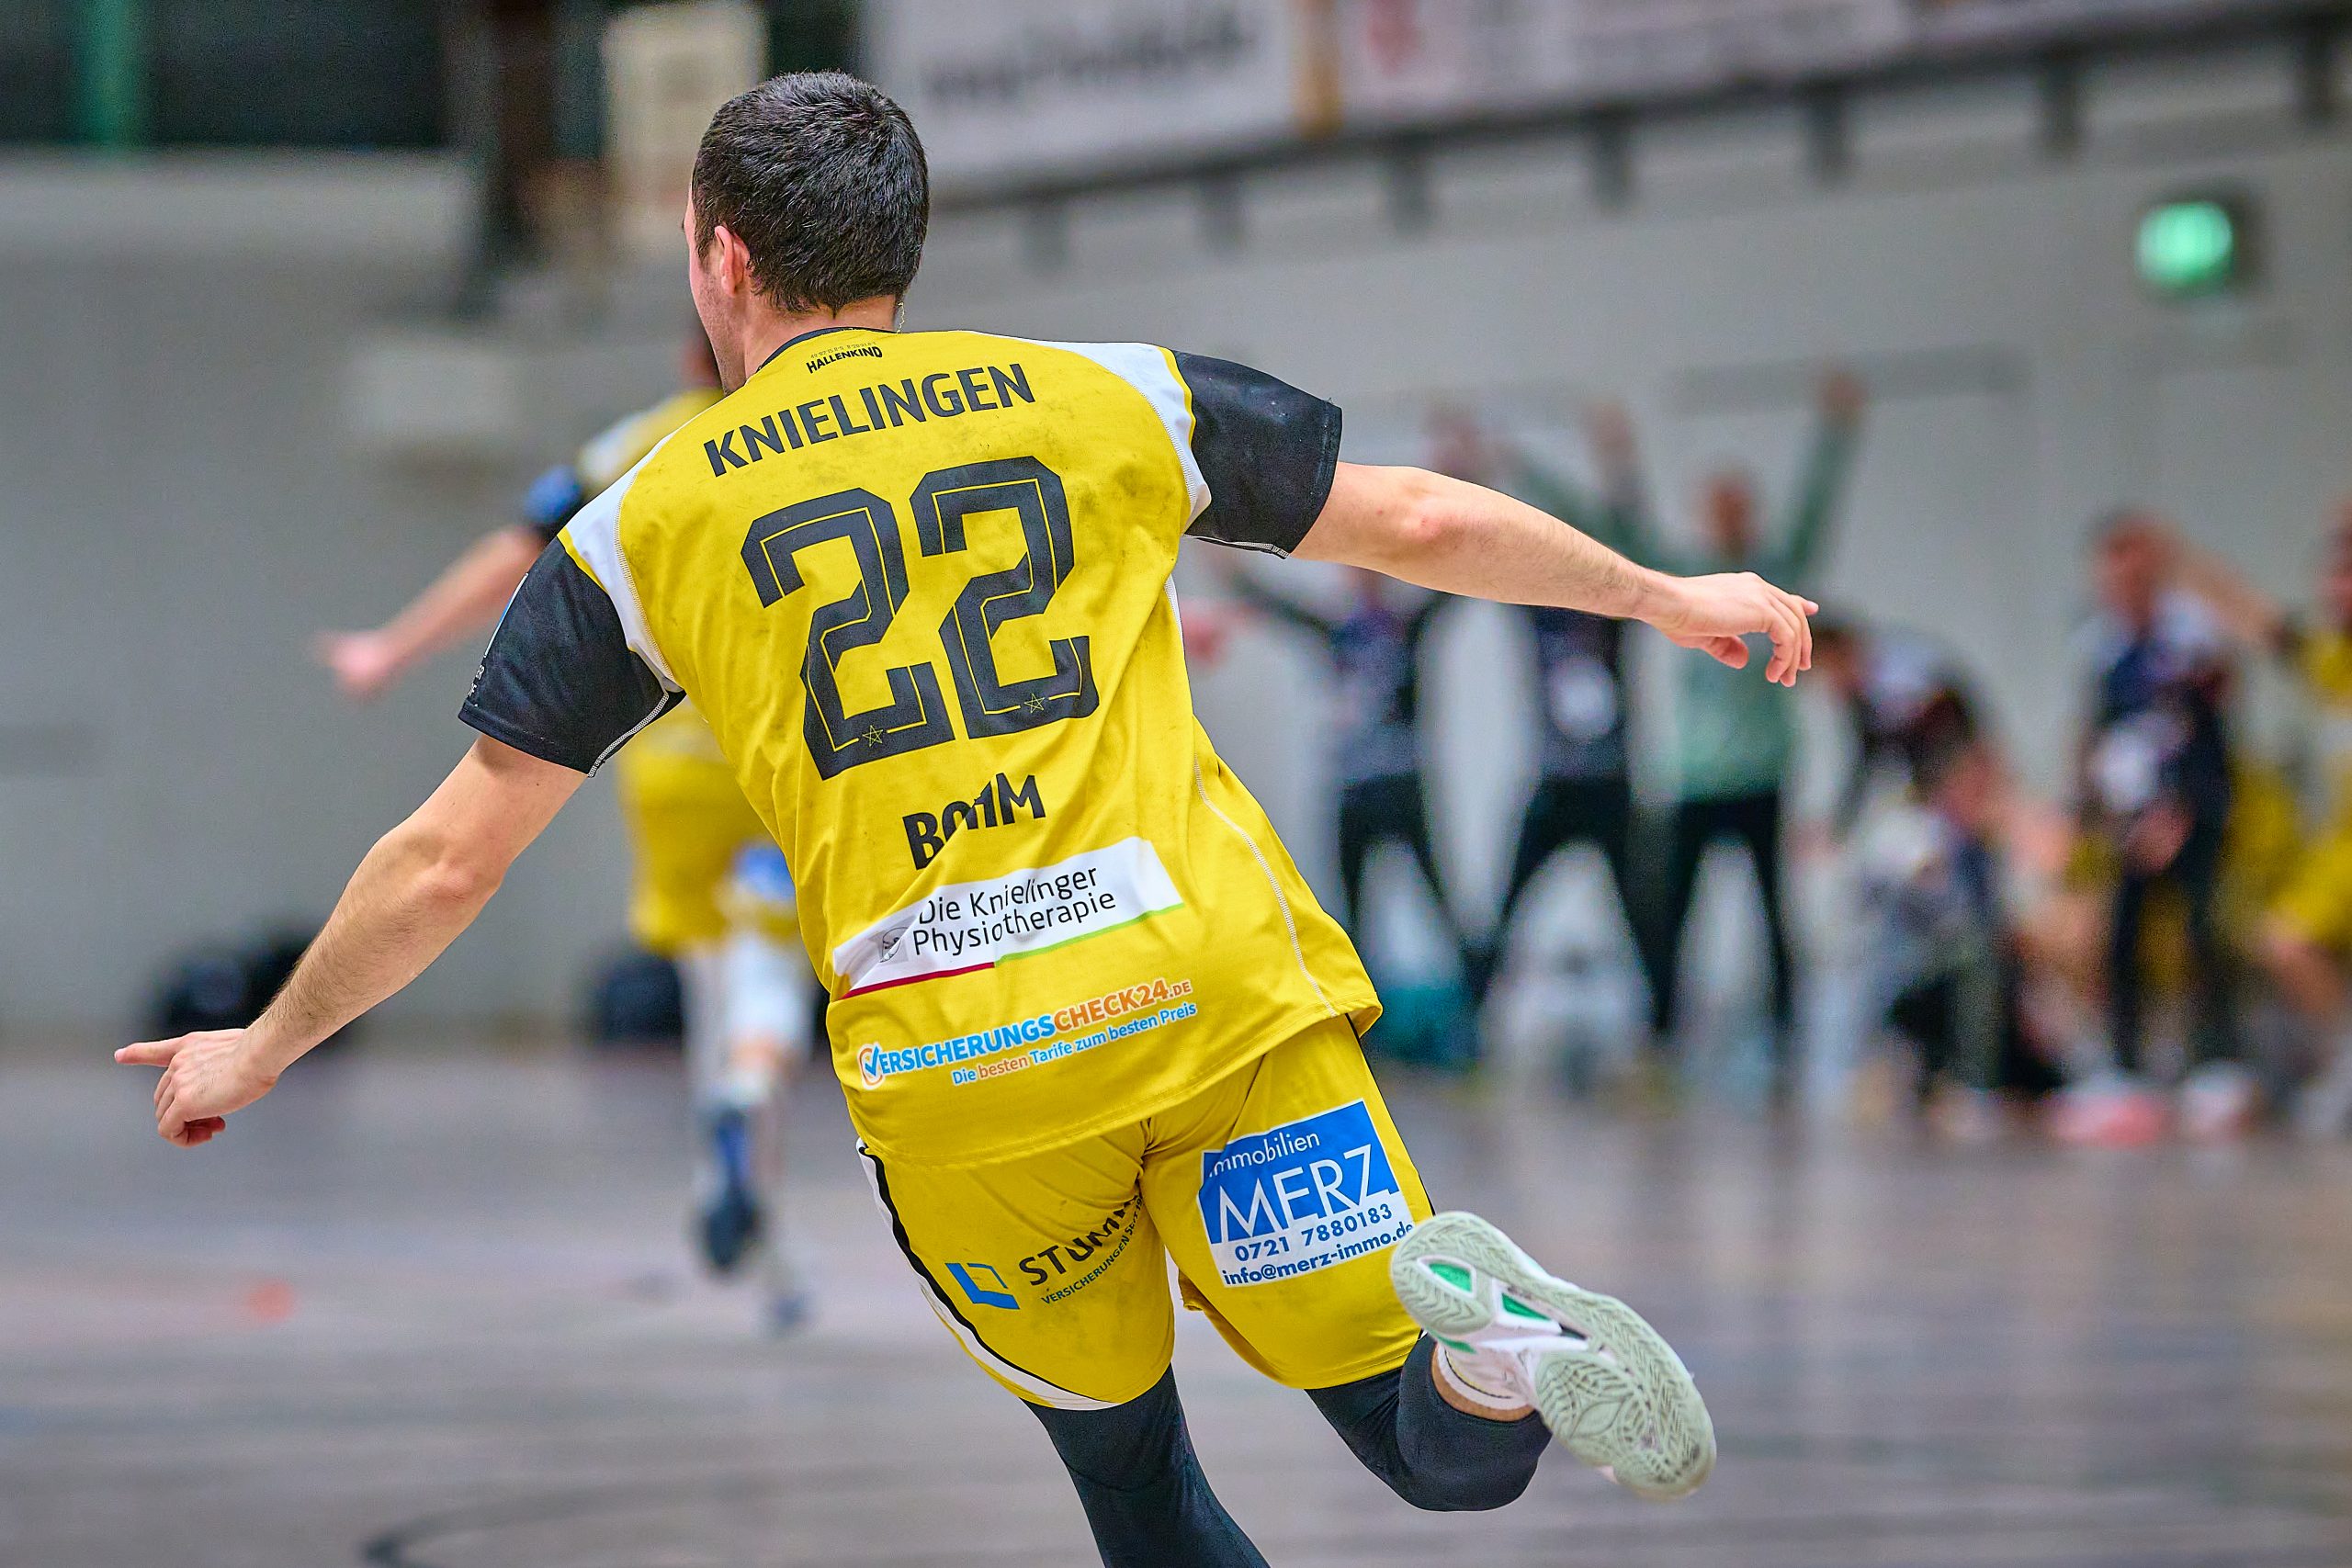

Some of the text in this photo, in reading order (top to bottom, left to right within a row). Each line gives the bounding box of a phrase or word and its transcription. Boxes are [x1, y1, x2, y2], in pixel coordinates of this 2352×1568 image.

[806, 346, 883, 375] HALLENKIND
[703, 363, 1035, 478] KNIELINGEN
[741, 456, 1100, 781] 22
[913, 892, 1116, 956] Physiotherapie
[919, 867, 1097, 924] Die Knielinger
[953, 1003, 1197, 1085] Die besten Tarife zum besten Preis
[1209, 1131, 1321, 1179] mmobilien
[1219, 1144, 1393, 1244] MERZ
[1019, 1200, 1133, 1286] STUM
[1234, 1203, 1393, 1262] 0721 7880183
[1041, 1235, 1130, 1304] VERSICHERUNGEN
